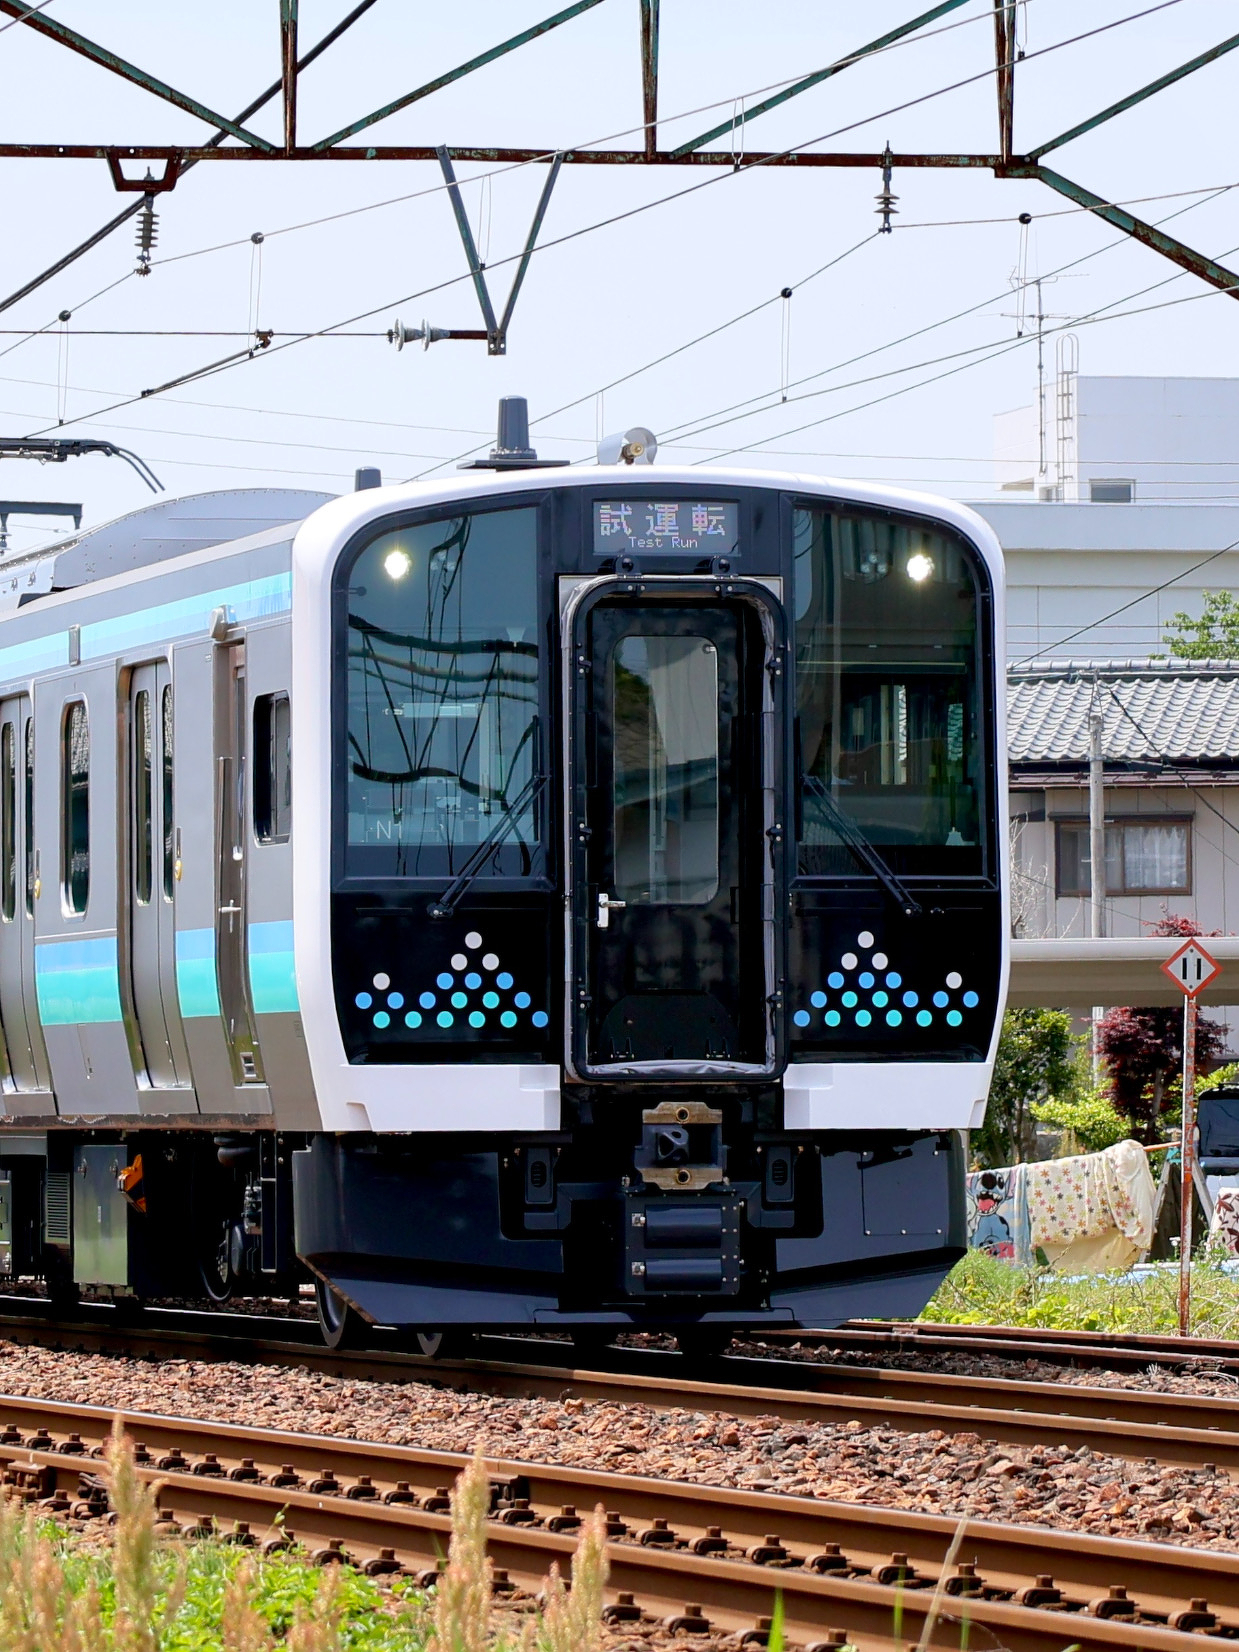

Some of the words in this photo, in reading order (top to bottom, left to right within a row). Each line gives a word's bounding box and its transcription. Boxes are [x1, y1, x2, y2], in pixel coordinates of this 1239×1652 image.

[599, 503, 726, 536] 試運転
[628, 536, 663, 549] Test
[671, 536, 698, 549] Run
